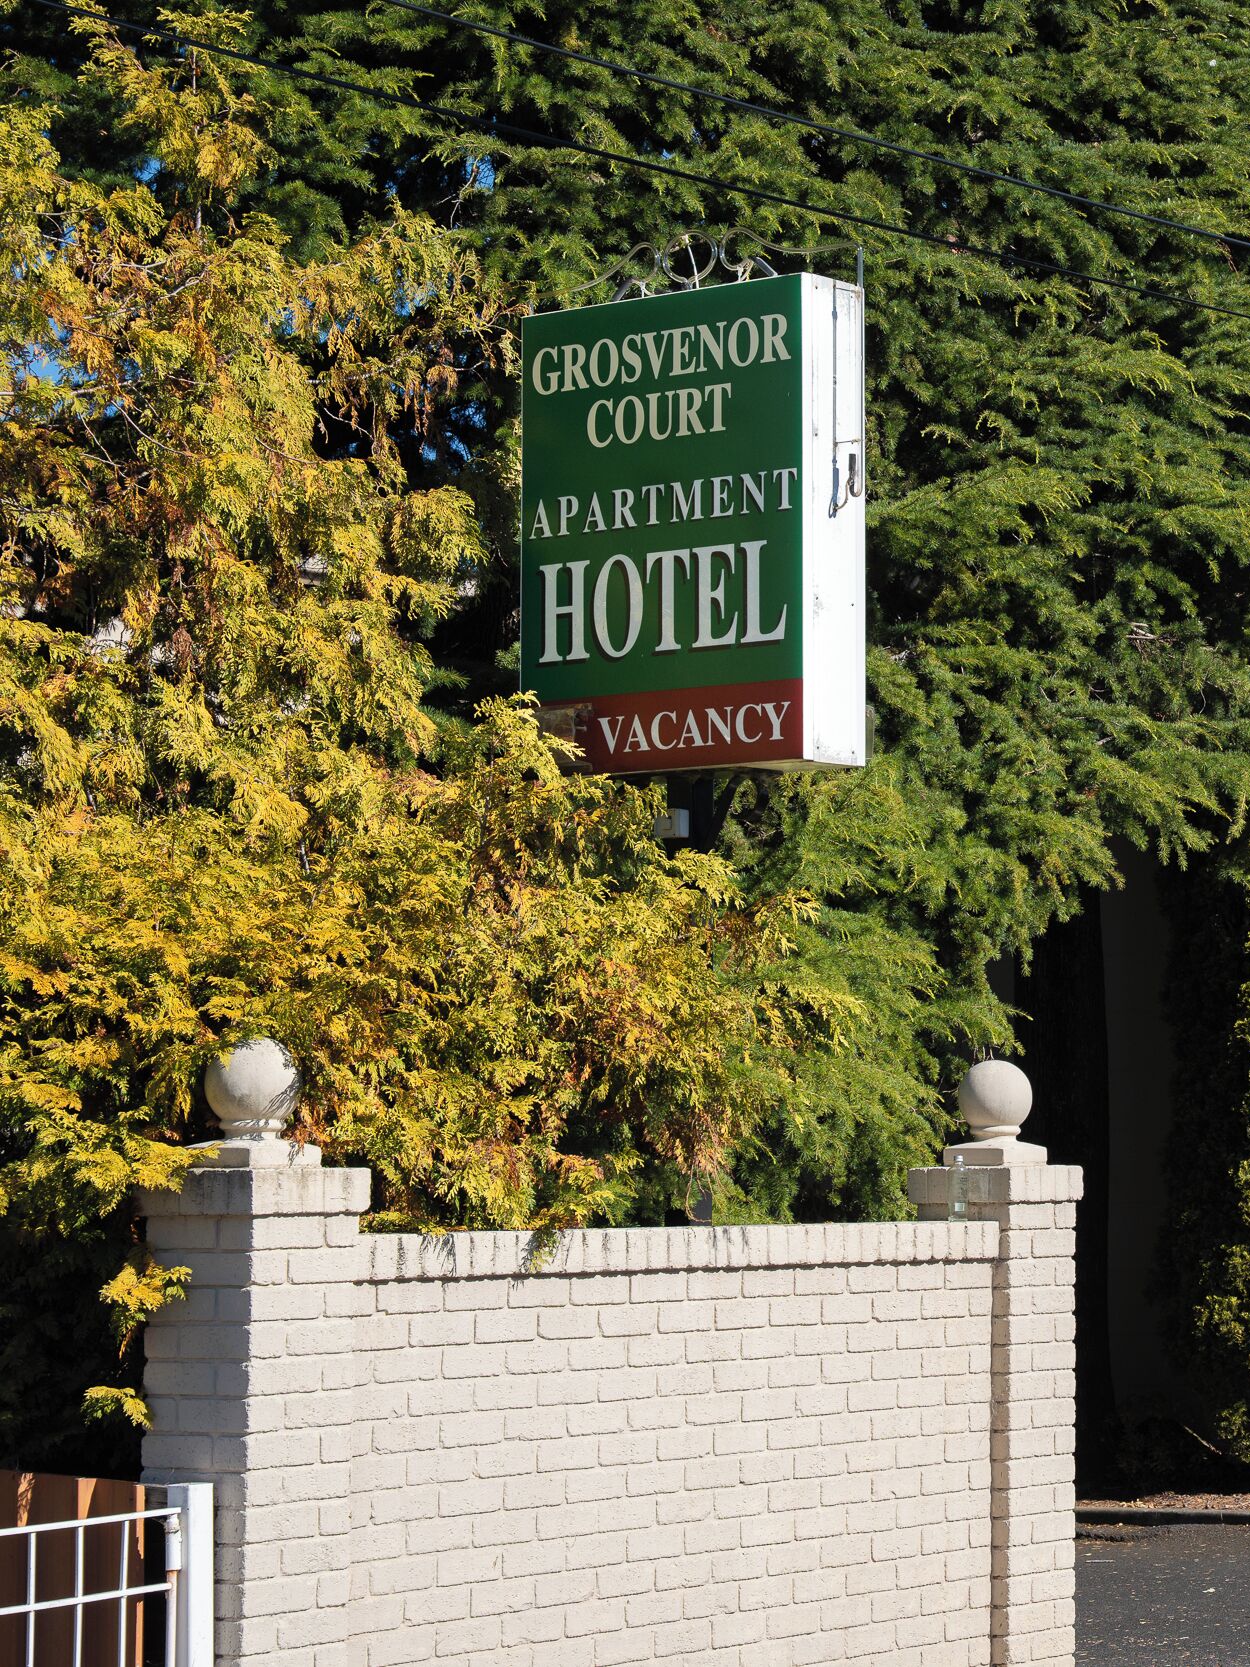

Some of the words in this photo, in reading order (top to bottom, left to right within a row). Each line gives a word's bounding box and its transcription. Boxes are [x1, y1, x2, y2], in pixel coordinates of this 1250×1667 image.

[532, 313, 791, 395] GROSVENOR
[587, 383, 731, 447] COURT
[530, 467, 798, 539] APARTMENT
[539, 540, 787, 662] HOTEL
[598, 701, 790, 754] VACANCY
